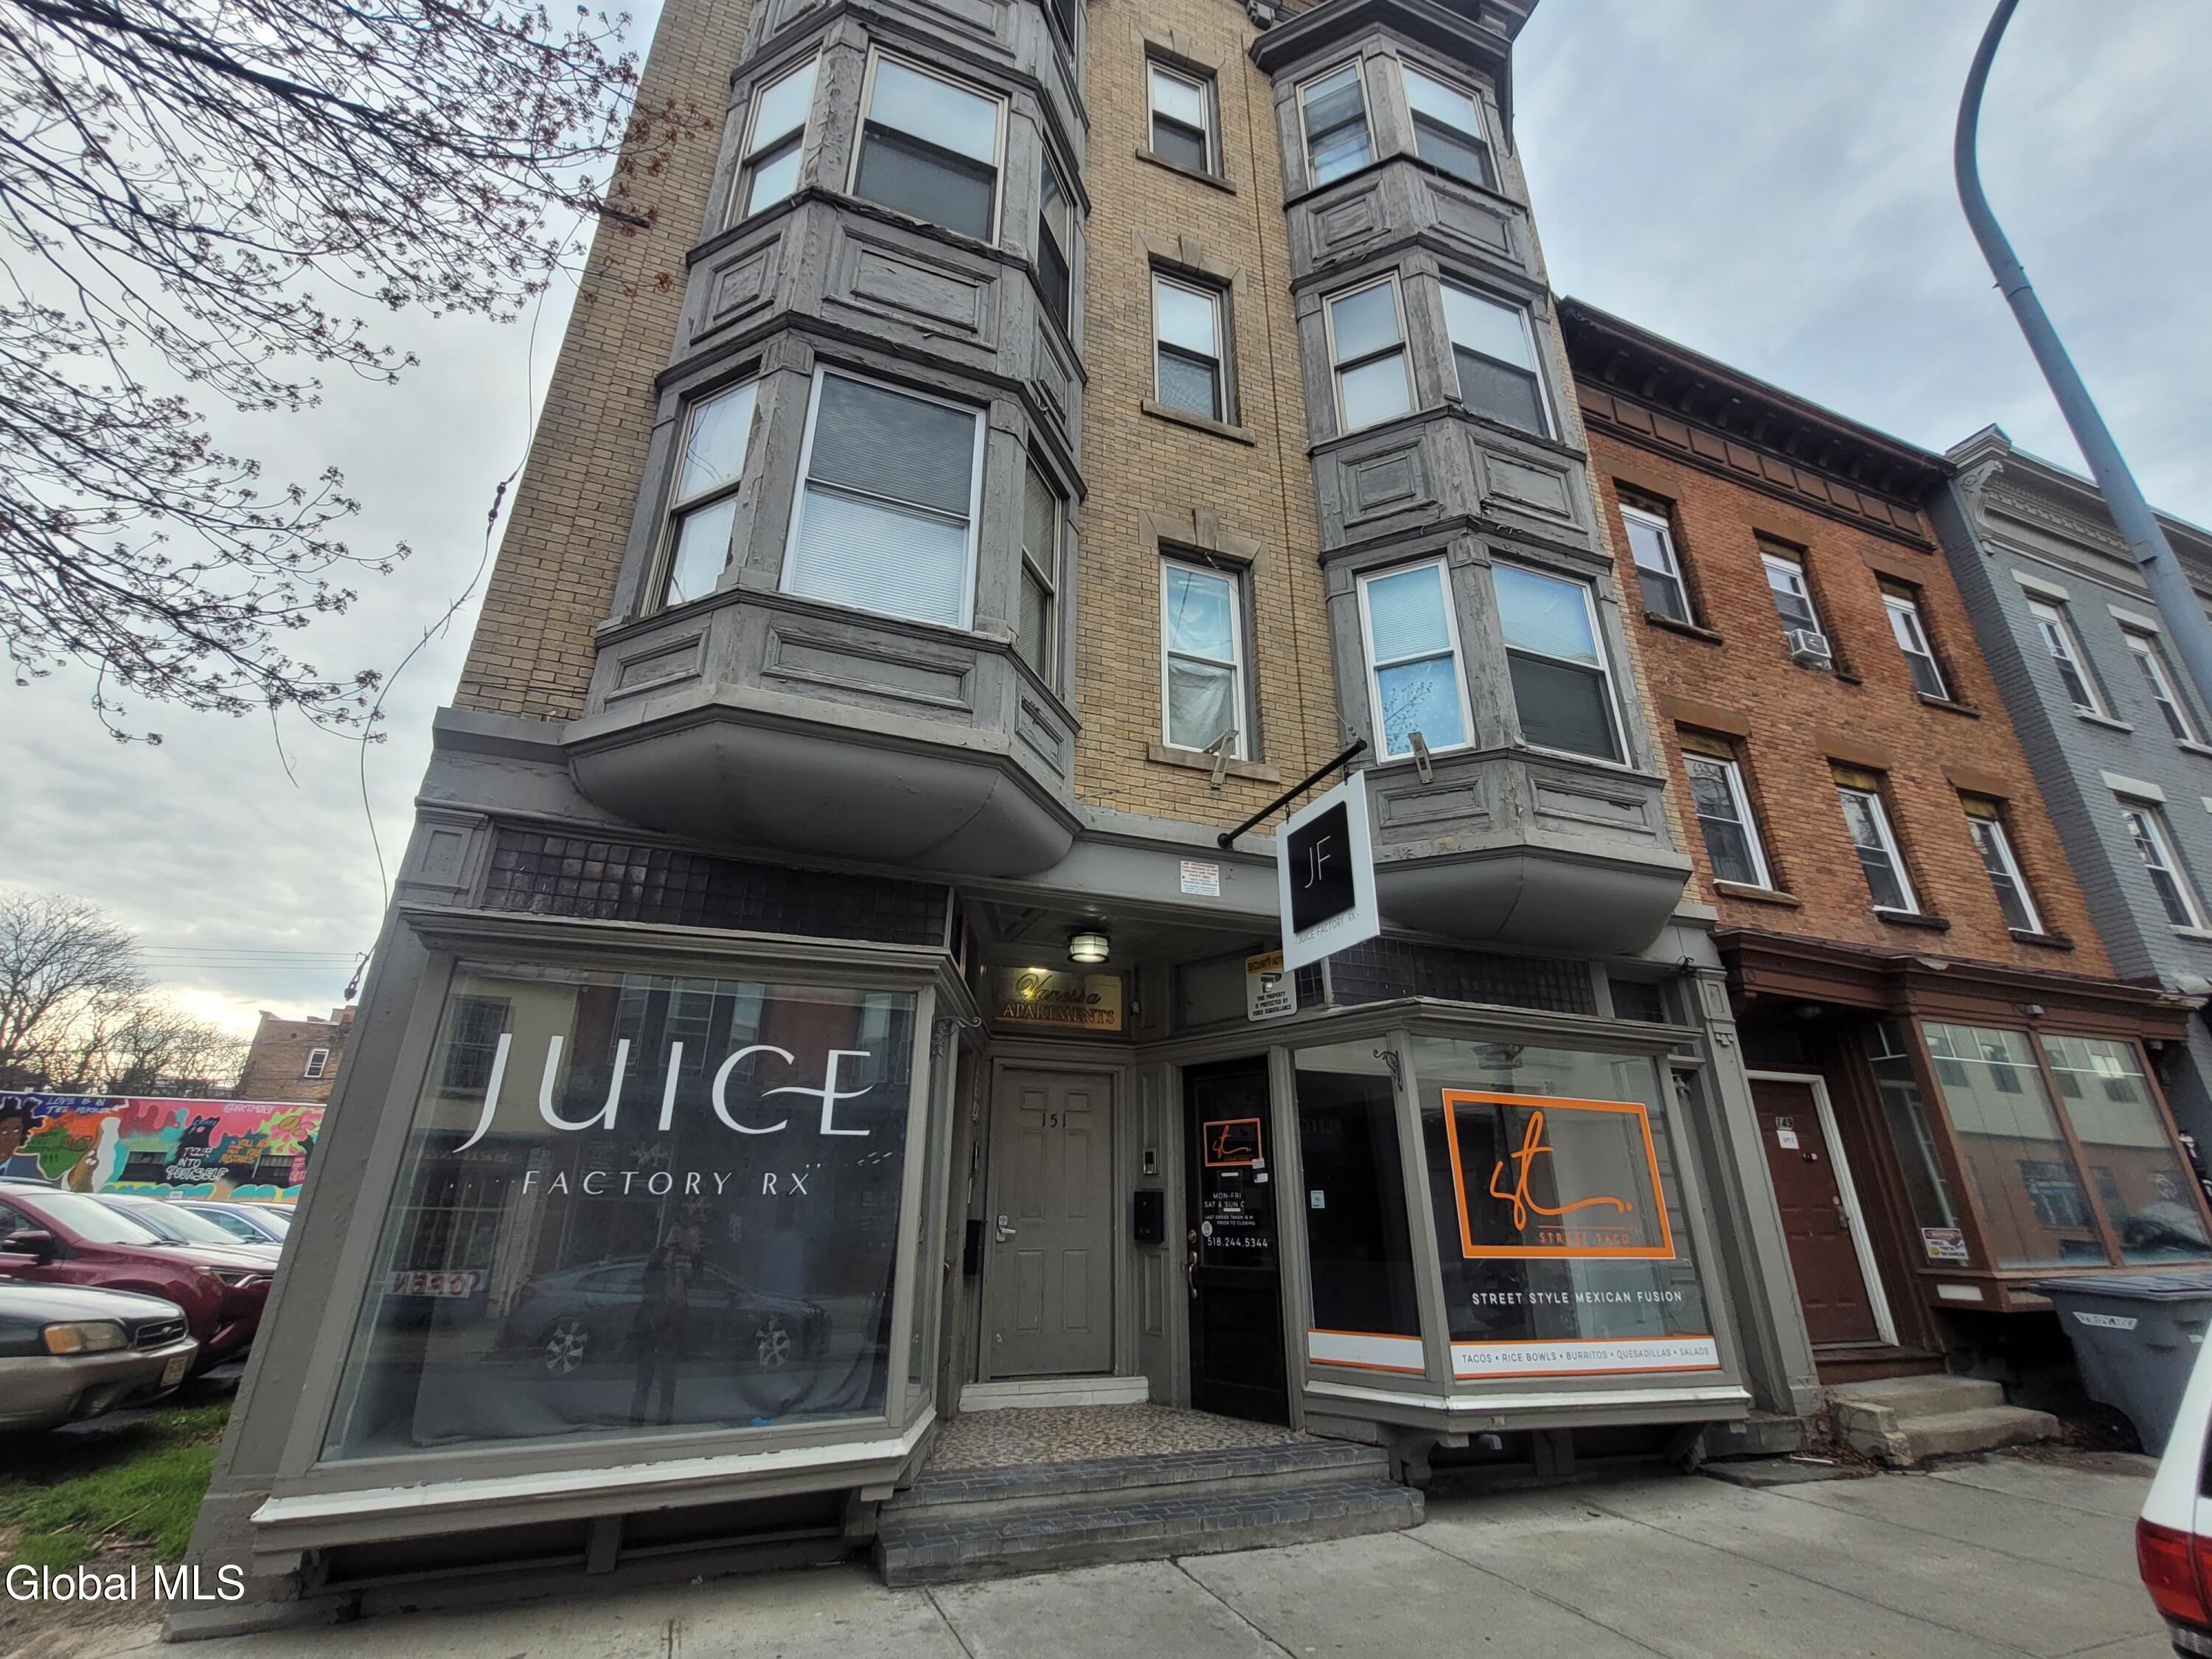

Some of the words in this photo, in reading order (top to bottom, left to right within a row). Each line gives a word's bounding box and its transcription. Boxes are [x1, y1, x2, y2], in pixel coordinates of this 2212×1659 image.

[1304, 835, 1331, 888] JF
[1317, 917, 1345, 936] FACTORY
[1266, 991, 1286, 1000] PROPERTY
[1002, 1003, 1115, 1025] APARTMENTS
[453, 1033, 874, 1153] JUICE
[46, 1097, 76, 1106] LOVE
[1042, 1112, 1066, 1128] 151
[178, 1157, 201, 1168] INTO
[166, 1165, 229, 1181] YOURSELF
[523, 1171, 731, 1195] FACTORY
[763, 1172, 808, 1195] RX
[1208, 1237, 1268, 1248] 518.244.5344
[1472, 1292, 1523, 1305] STREET
[1529, 1292, 1570, 1304] STYLE
[1575, 1291, 1632, 1304] MEXICAN
[1637, 1290, 1683, 1303] FUSION
[1462, 1354, 1492, 1364] TACOS
[1502, 1352, 1523, 1363] RICE
[1526, 1352, 1557, 1362] BOWLS
[1566, 1350, 1608, 1361] BURRITOS
[1616, 1349, 1672, 1360] QUESADILLAS
[1679, 1347, 1710, 1357] SALADS
